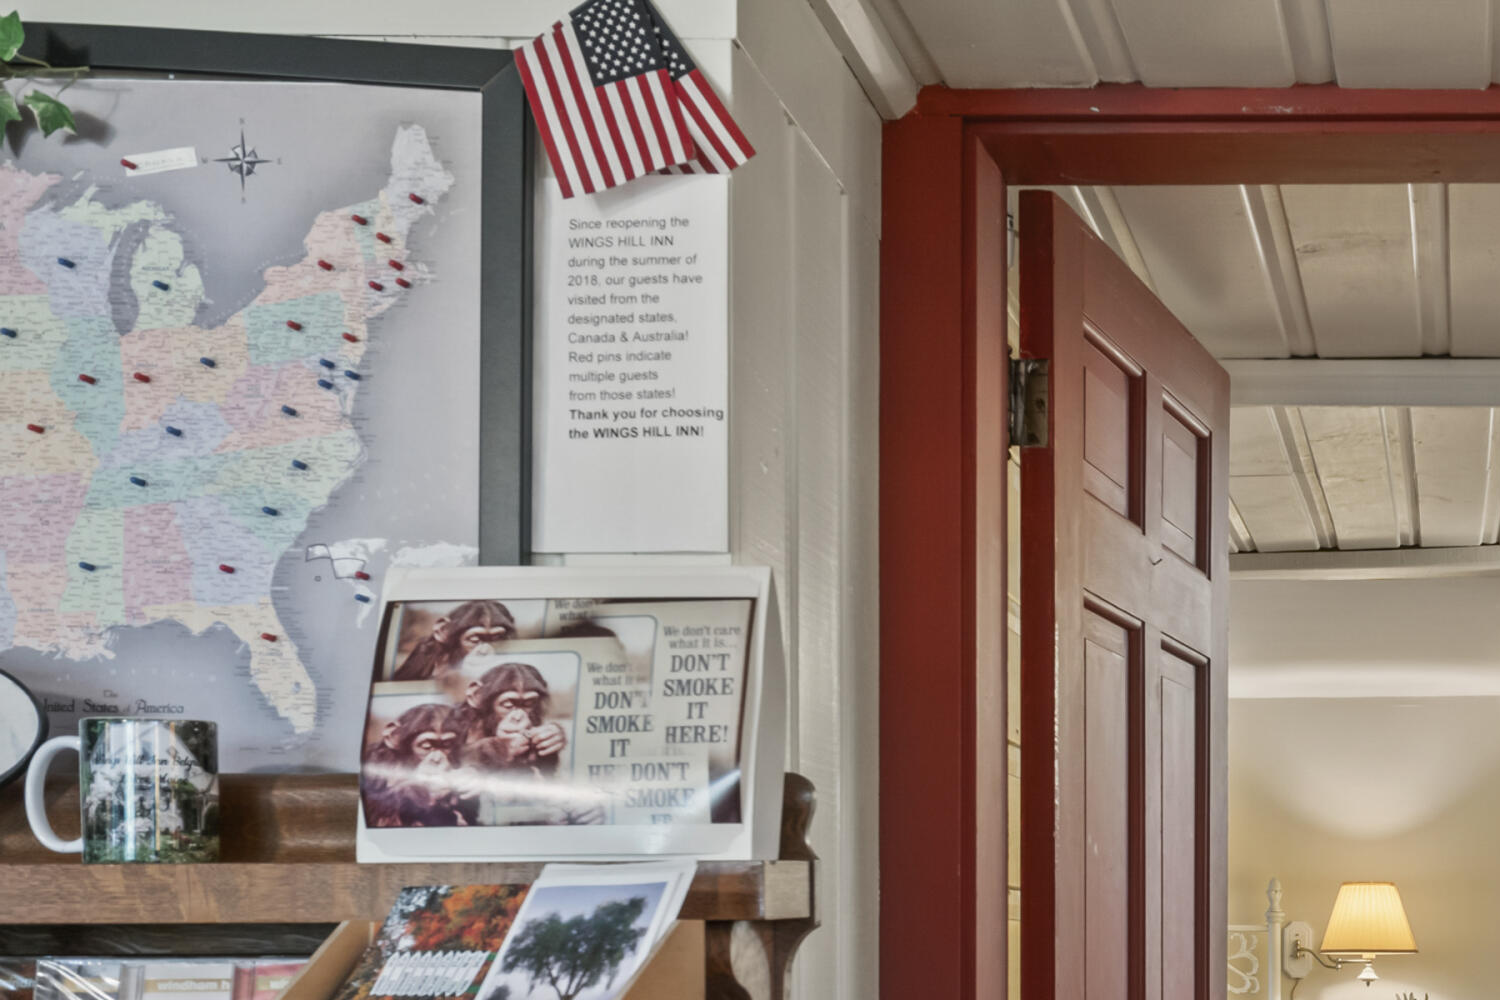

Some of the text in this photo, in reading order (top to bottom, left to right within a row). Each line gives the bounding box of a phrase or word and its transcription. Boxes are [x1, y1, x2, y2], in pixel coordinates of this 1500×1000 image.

[569, 217, 689, 230] Since reopening the
[568, 236, 673, 248] WINGS HILL INN
[568, 254, 697, 269] during the summer of
[568, 273, 703, 287] 2018, our guests have
[568, 294, 659, 305] visited from the
[568, 313, 677, 326] designated states,
[568, 331, 689, 343] Canada & Australia!
[568, 351, 672, 364] Red pins indicate
[569, 370, 658, 383] multiple guests
[569, 387, 675, 401] from those states!
[570, 407, 724, 422] Thank you for choosing
[569, 426, 704, 439] the WINGS HILL INN!
[663, 626, 741, 636] We don't care
[669, 640, 698, 648] what
[702, 639, 710, 648] it
[587, 663, 602, 673] We
[670, 654, 730, 673] DON'T
[592, 676, 621, 686] what
[663, 678, 734, 696] SMOKE
[83, 699, 119, 713] States
[135, 699, 184, 713] America
[687, 702, 708, 719] IT
[586, 715, 654, 734] SMOKE
[665, 725, 728, 743] HERE!
[610, 739, 630, 758] IT
[631, 762, 689, 781] DON'T
[624, 788, 695, 807] SMOKE
[157, 980, 217, 990] windham
